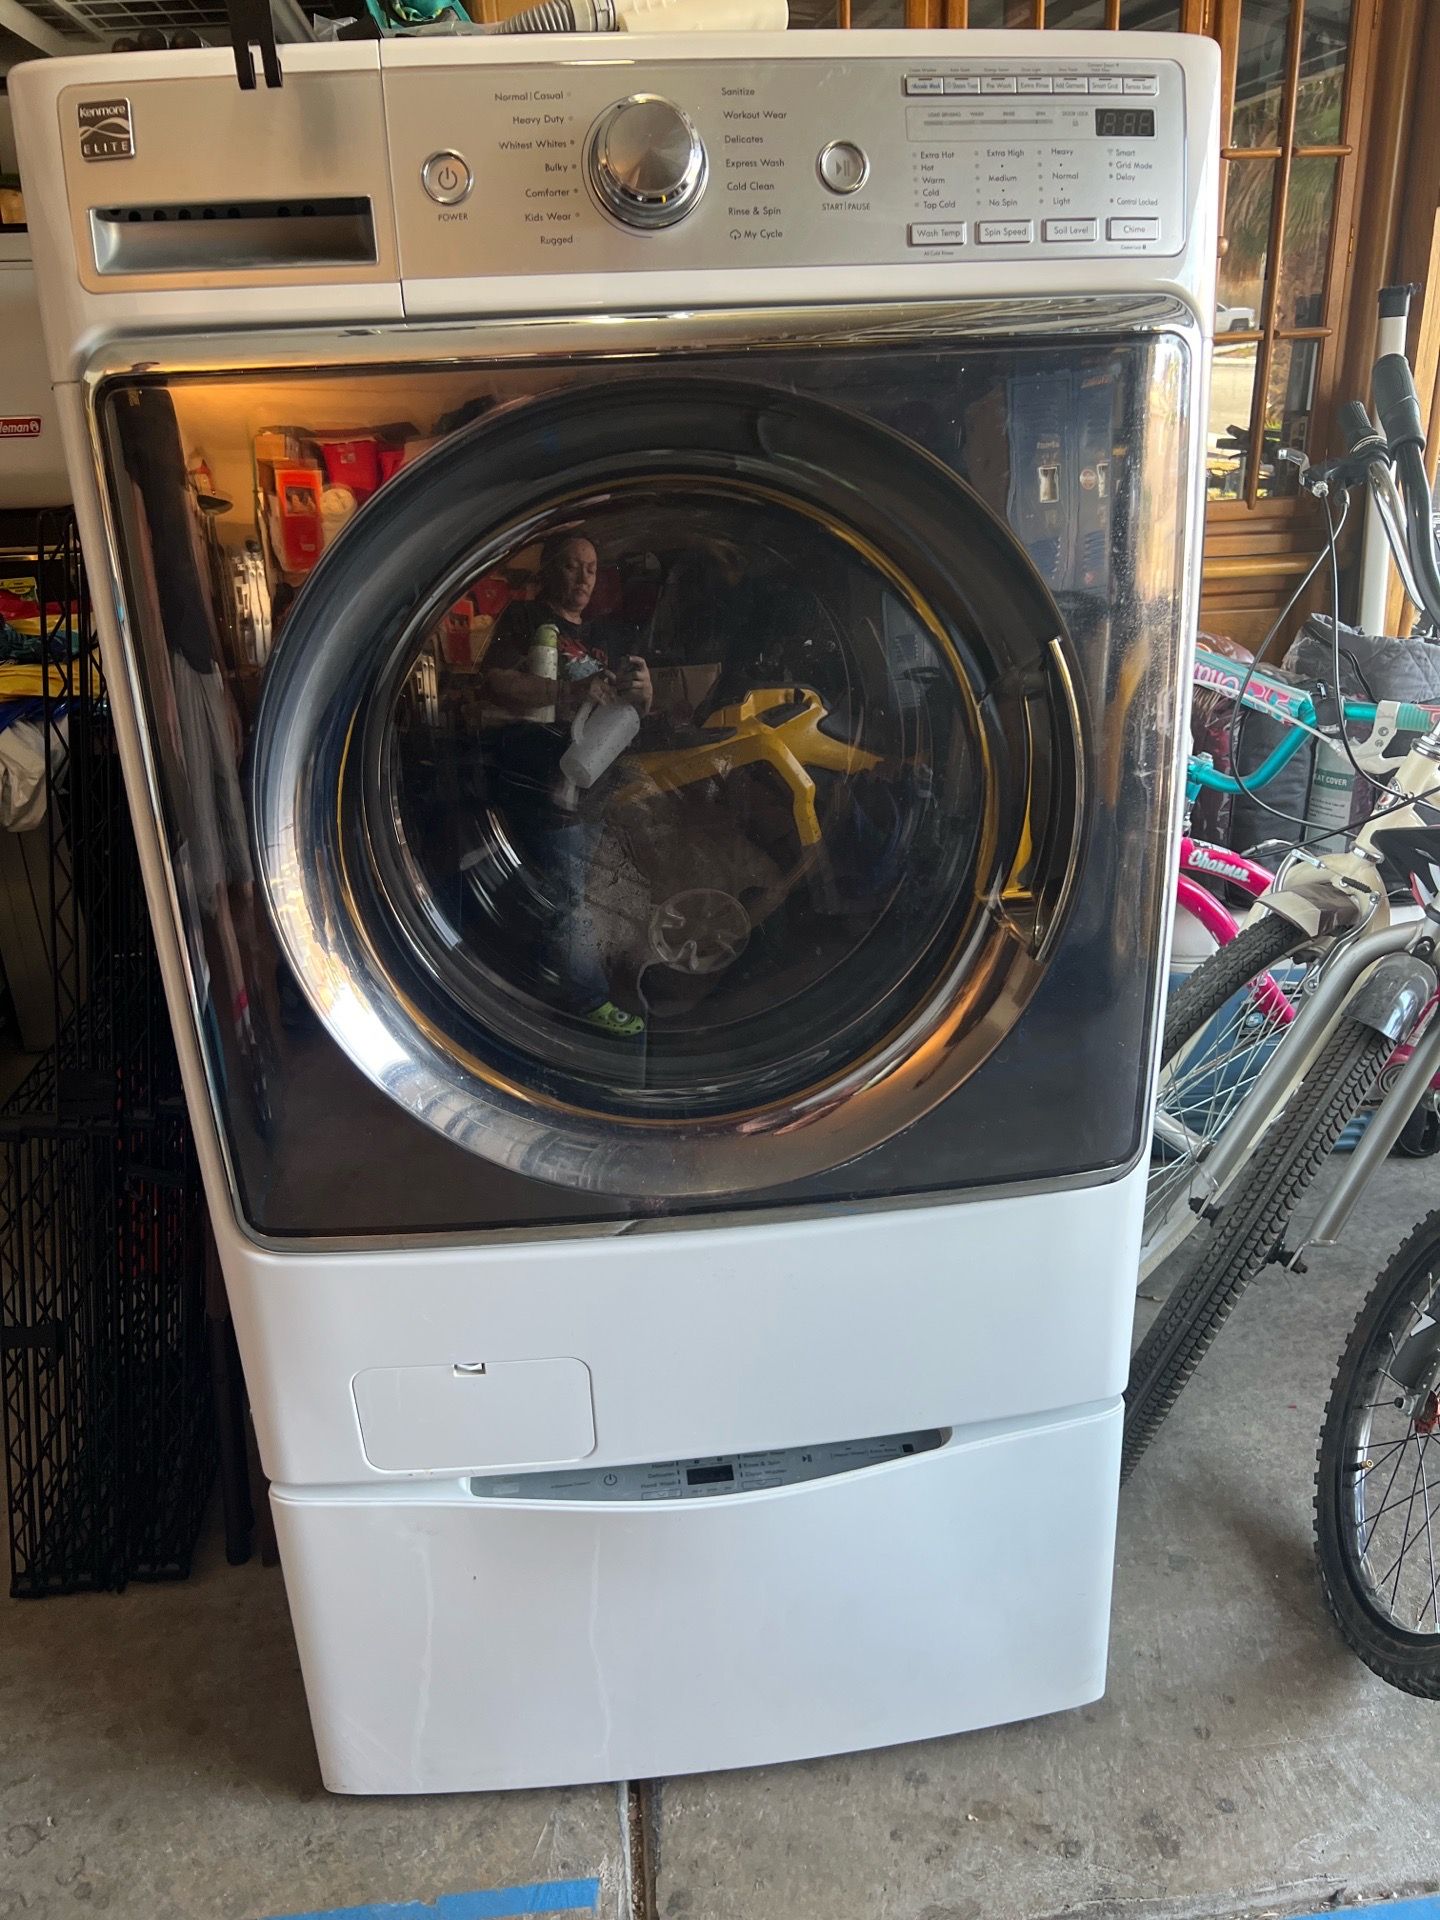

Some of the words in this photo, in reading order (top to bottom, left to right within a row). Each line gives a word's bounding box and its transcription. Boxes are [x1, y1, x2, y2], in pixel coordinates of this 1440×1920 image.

[721, 87, 755, 97] Sanitize
[80, 106, 126, 119] Kenmore
[723, 111, 760, 120] Workout
[763, 110, 787, 119] Wear
[512, 115, 541, 126] Heavy
[544, 114, 565, 124] Duty
[725, 135, 764, 144] Delicates
[83, 141, 129, 155] ELITE
[499, 141, 532, 150] Whitest
[535, 140, 567, 149] Whites
[920, 151, 940, 160] Extra
[941, 151, 955, 159] Hot
[986, 149, 1006, 158] Extra
[1007, 148, 1025, 159] High
[1051, 148, 1074, 157] Heavy
[1115, 148, 1136, 157] Smart
[544, 163, 568, 174] Bulky
[725, 158, 758, 170] Express
[760, 157, 785, 168] Wash
[921, 164, 934, 172] Hot
[1115, 161, 1132, 170] Grid
[1133, 161, 1153, 170] Mode
[922, 176, 946, 185] Warm
[988, 173, 1018, 183] Medium
[1052, 172, 1079, 181] Normal
[1115, 172, 1136, 182] Delay
[726, 182, 747, 191] Cold
[750, 182, 775, 191] Clean
[525, 187, 570, 198] Comforter
[922, 188, 940, 197] Cold
[938, 200, 956, 209] Cold
[988, 199, 1000, 207] No
[1002, 199, 1018, 208] Spin
[1052, 198, 1071, 207] Light
[728, 206, 750, 216] Rinse
[752, 206, 760, 215] &
[763, 206, 781, 217] Spin
[437, 213, 469, 223] POWER
[525, 213, 543, 223] Kids
[546, 211, 571, 222] Wear
[917, 229, 939, 238] Wash
[940, 228, 961, 239] Temp
[984, 227, 1001, 238] Spin
[1003, 227, 1027, 237] Speed
[1053, 225, 1068, 235] Soil
[1069, 224, 1089, 235] Level
[1123, 224, 1146, 234] Chime
[744, 229, 757, 240] My
[760, 229, 783, 239] Cycle
[540, 235, 573, 246] Rugged
[1325, 776, 1348, 787] COVER
